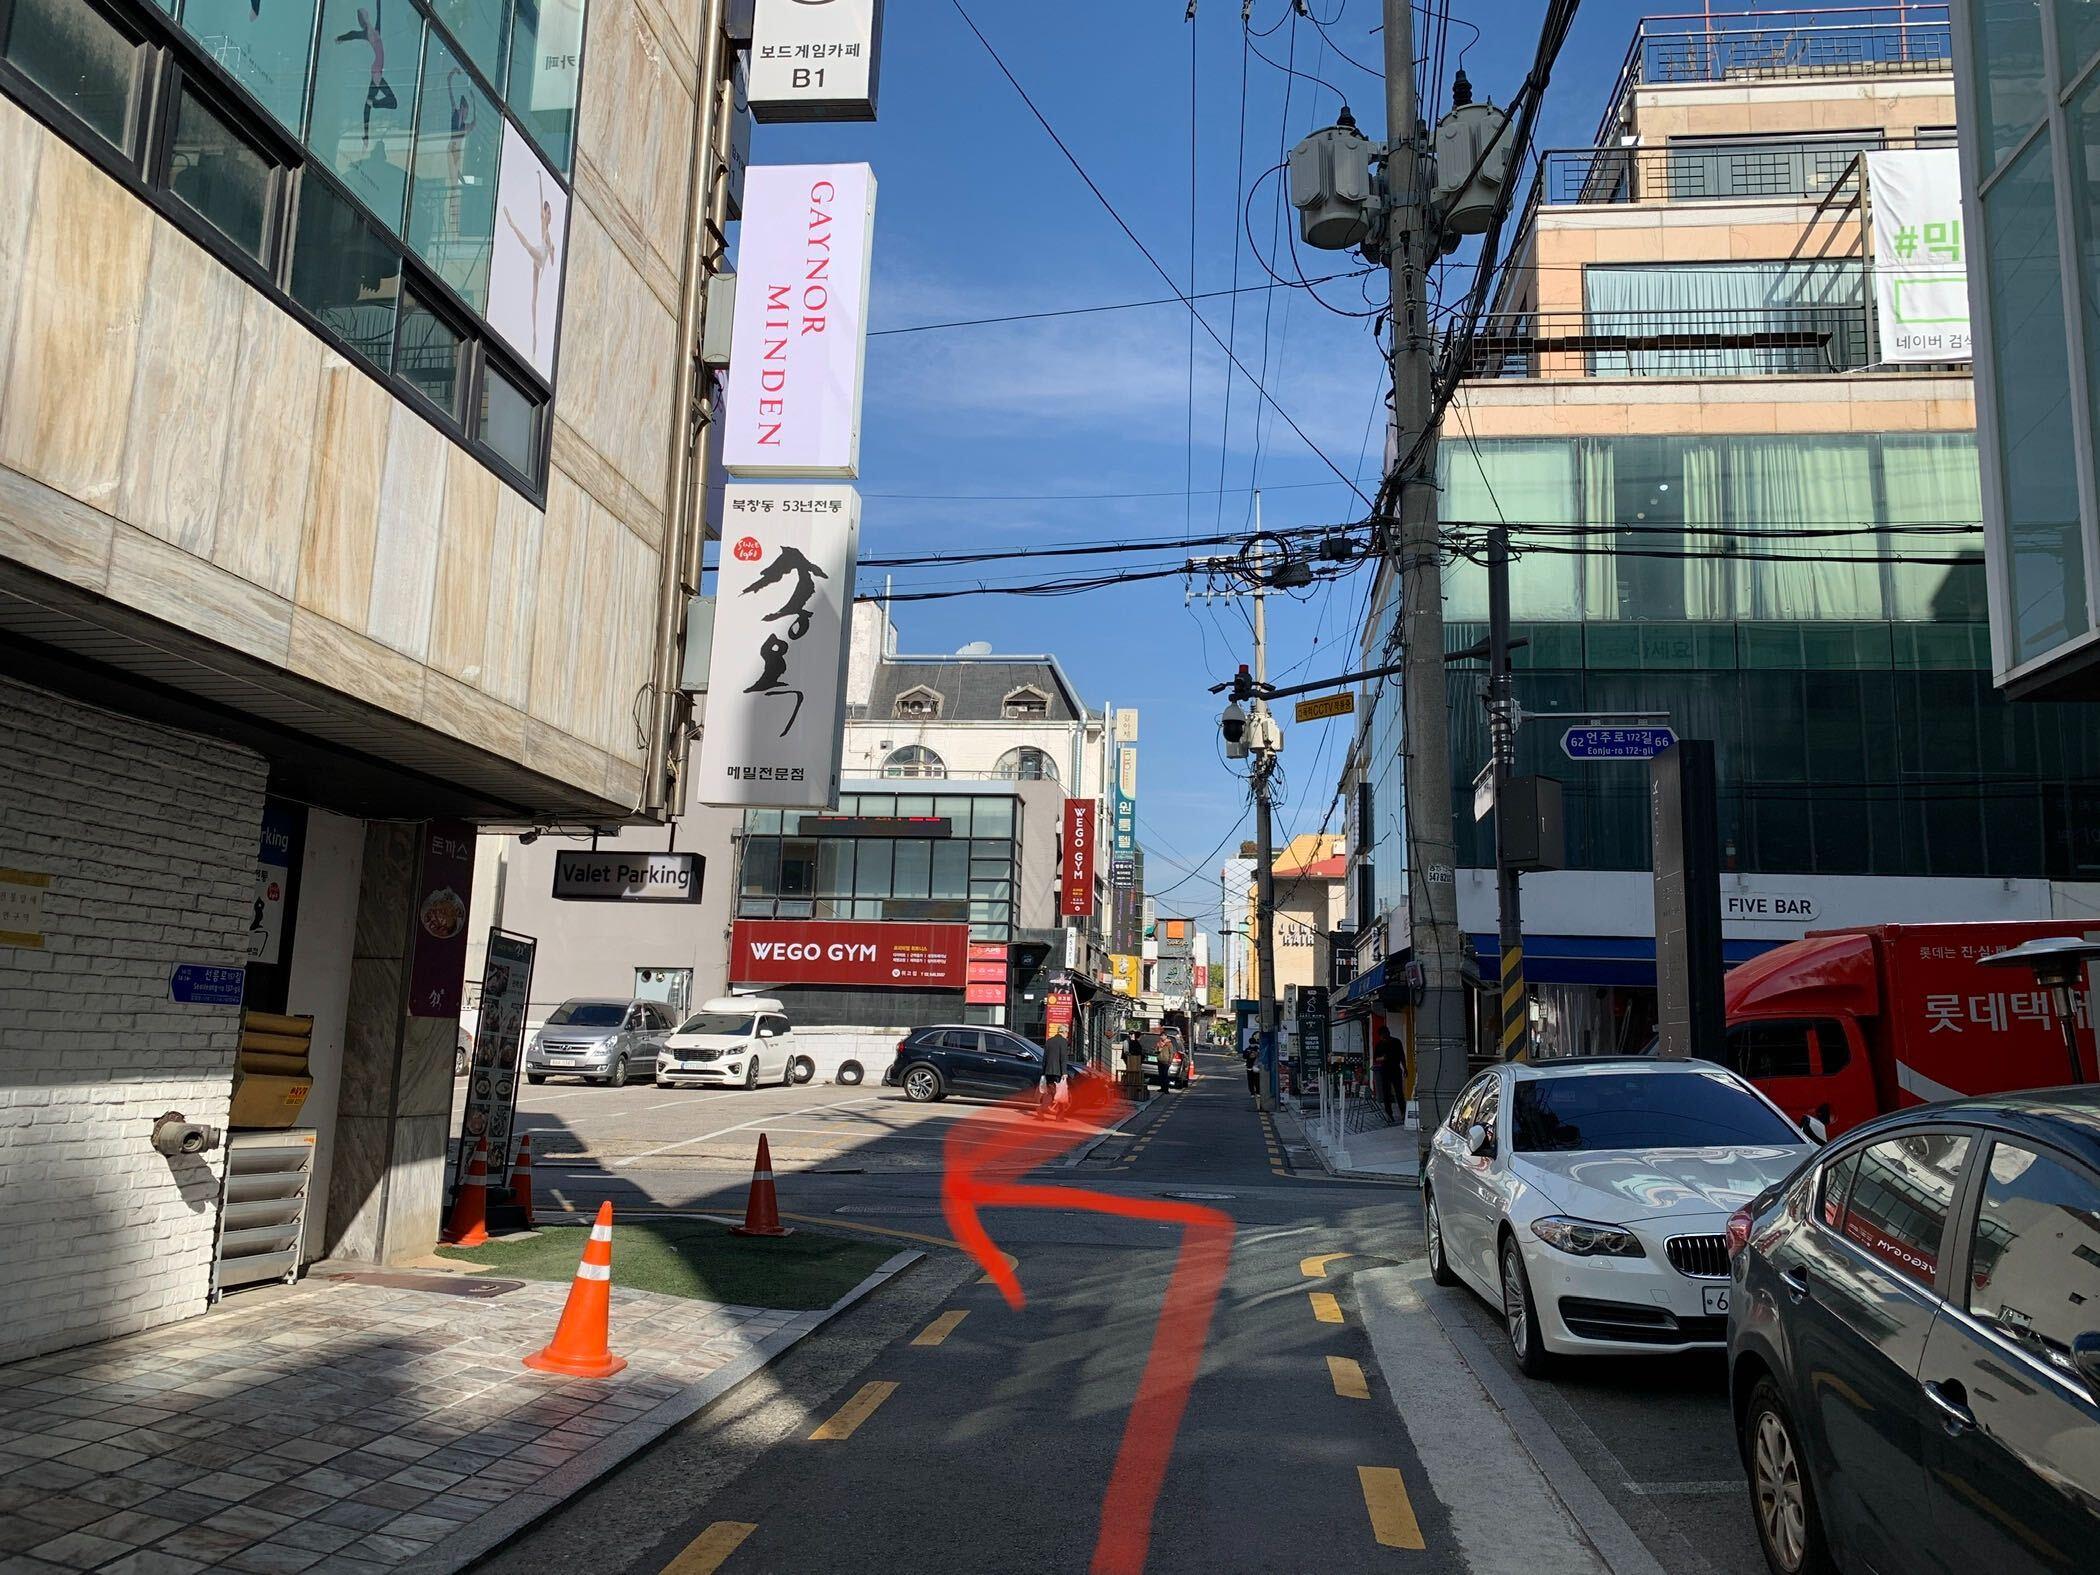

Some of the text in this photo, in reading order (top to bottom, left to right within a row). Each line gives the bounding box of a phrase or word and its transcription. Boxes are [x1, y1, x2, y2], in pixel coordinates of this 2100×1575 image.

[760, 43, 860, 59] 보드게임카페
[792, 68, 824, 88] B1
[800, 181, 835, 336] GAYNOR
[1896, 334, 1943, 350] 네이버
[757, 284, 791, 446] MINDEN
[732, 499, 843, 513] 북창동 53년전통
[1571, 731, 1669, 747] 62 언주로172길 66
[1587, 746, 1654, 756] Eonju-ro 172-gil
[727, 766, 805, 781] 메밀전문점
[1074, 808, 1086, 848] WEGO
[1073, 852, 1083, 880] GYM
[563, 863, 689, 888] Valet Parking
[1729, 898, 1811, 914] FIVE BAR
[1283, 934, 1315, 946] HAIR
[751, 942, 821, 961] WEGO
[827, 944, 877, 962] GYM
[1920, 946, 1957, 960] 롯데는
